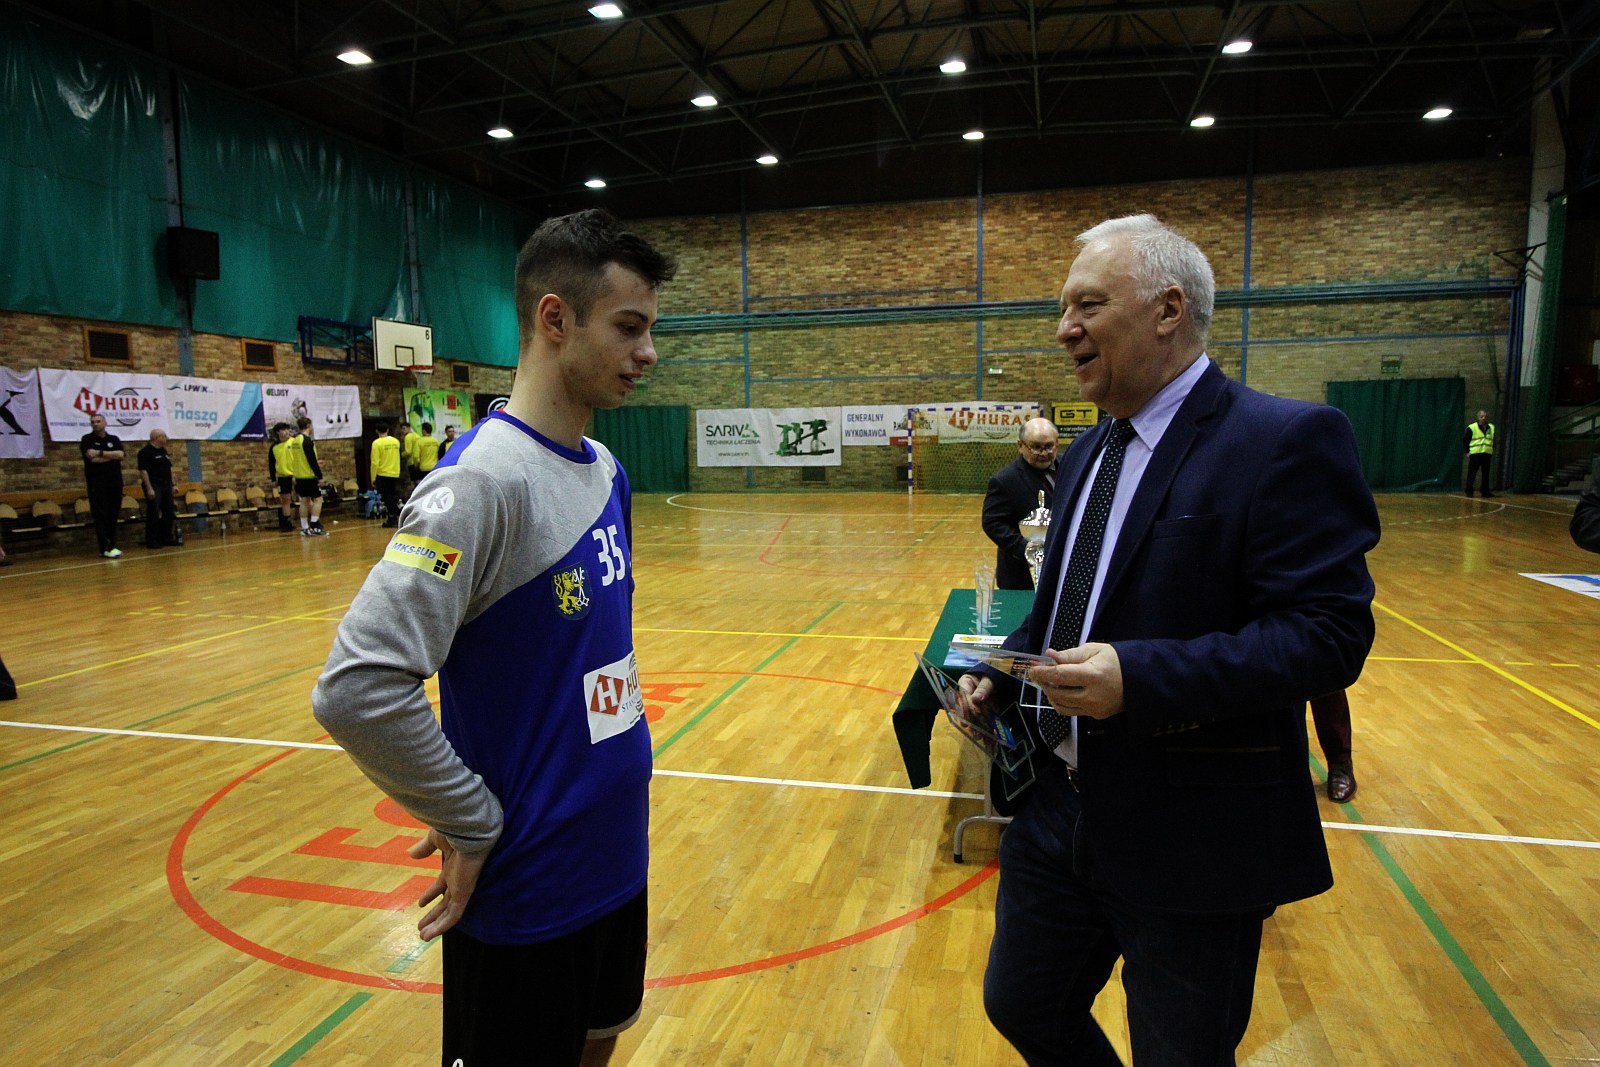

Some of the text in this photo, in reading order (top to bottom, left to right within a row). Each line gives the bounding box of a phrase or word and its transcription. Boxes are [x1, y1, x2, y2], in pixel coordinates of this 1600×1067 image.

[425, 329, 430, 341] 6
[104, 397, 160, 411] HURAS
[846, 413, 884, 423] GENERALNY
[1060, 409, 1093, 419] GT
[844, 428, 887, 438] WYKONAWCA
[392, 542, 438, 560] MKS-BUD
[591, 524, 626, 587] 35
